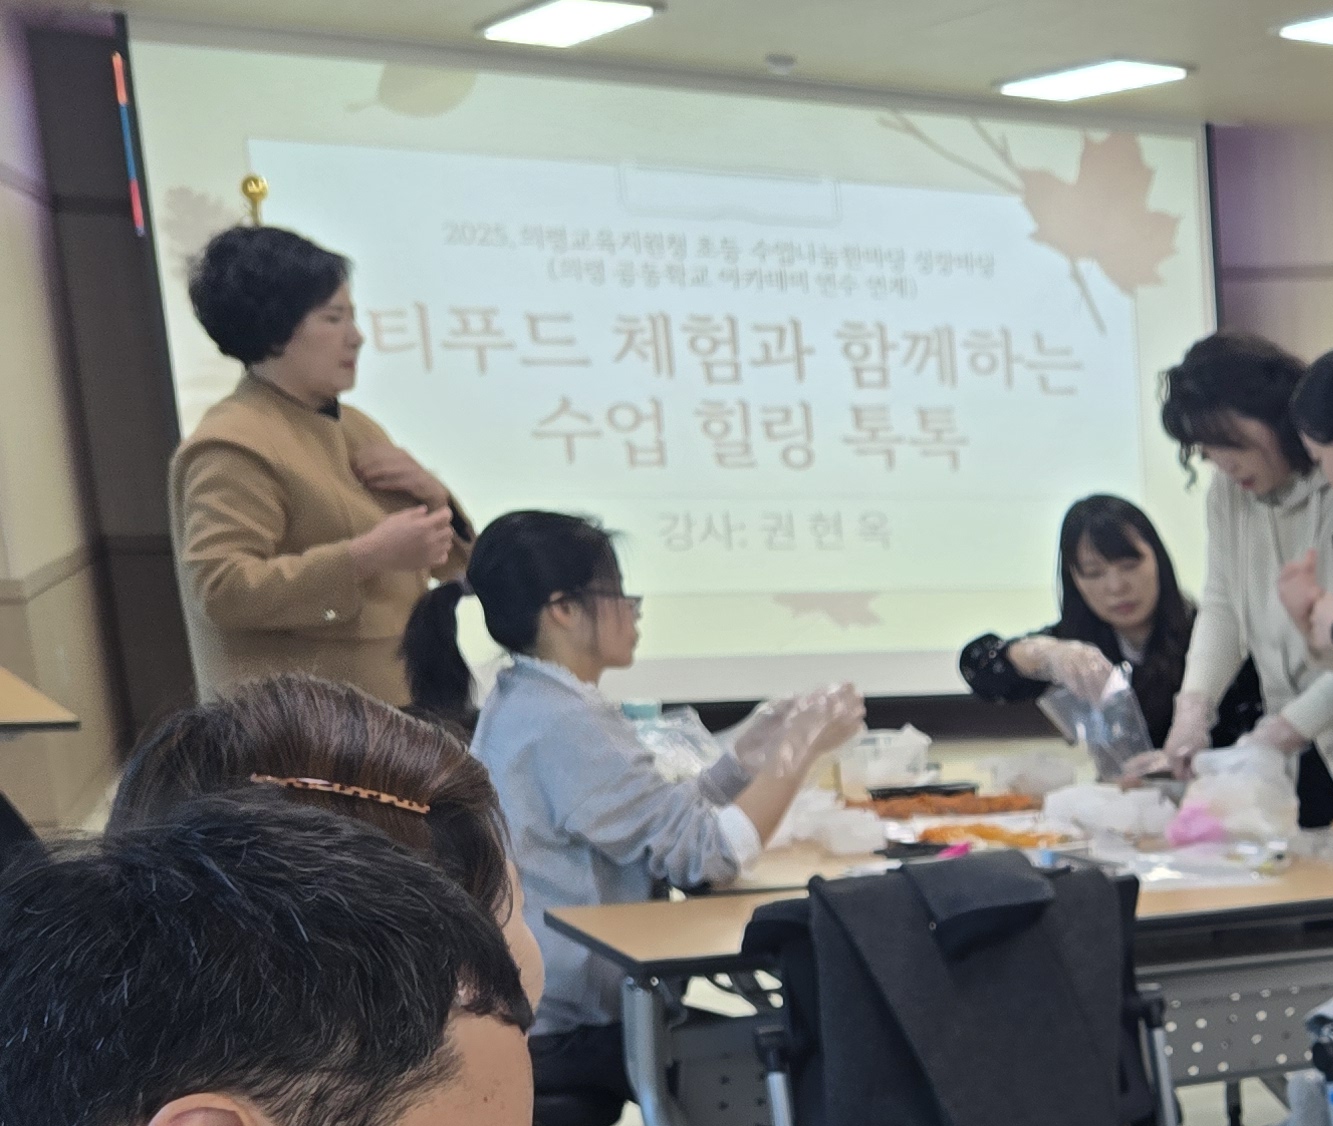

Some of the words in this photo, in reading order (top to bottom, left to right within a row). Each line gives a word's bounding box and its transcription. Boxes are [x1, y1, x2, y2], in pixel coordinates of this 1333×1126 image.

[366, 301, 592, 377] 티푸드
[612, 310, 816, 385] 체험과
[834, 320, 1085, 396] 함께하는
[530, 394, 668, 469] 수업
[692, 397, 815, 471] 힐링
[840, 404, 970, 473] 톡톡
[656, 509, 748, 552] 강사:
